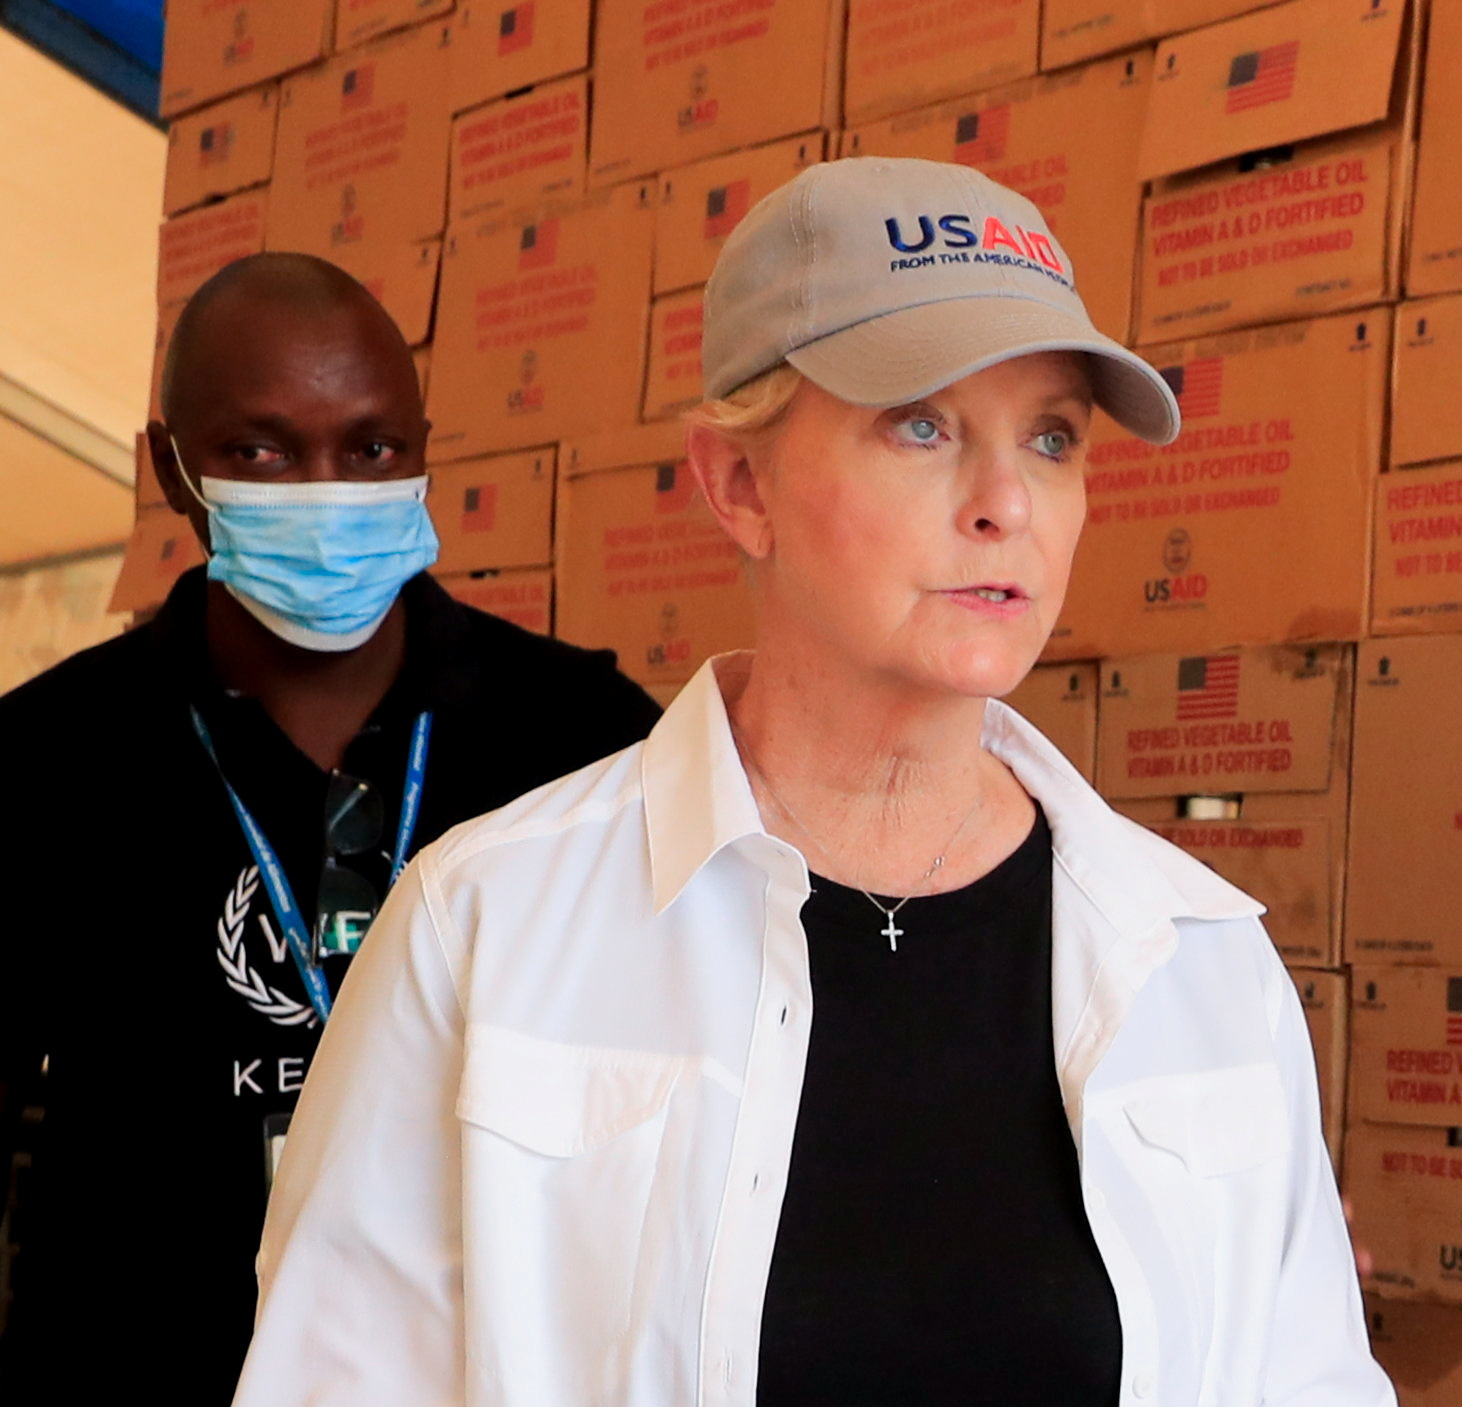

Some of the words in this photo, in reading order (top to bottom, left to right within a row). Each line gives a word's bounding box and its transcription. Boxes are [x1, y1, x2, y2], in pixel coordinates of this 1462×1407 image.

[1150, 196, 1218, 230] REFINED
[1224, 166, 1330, 208] VEGETABLE
[1336, 160, 1366, 185] OIL
[885, 215, 1065, 273] USAID
[891, 255, 935, 272] FROM
[939, 252, 969, 264] THE
[974, 253, 1044, 274] AMERICAN
[233, 1057, 307, 1096] KE
